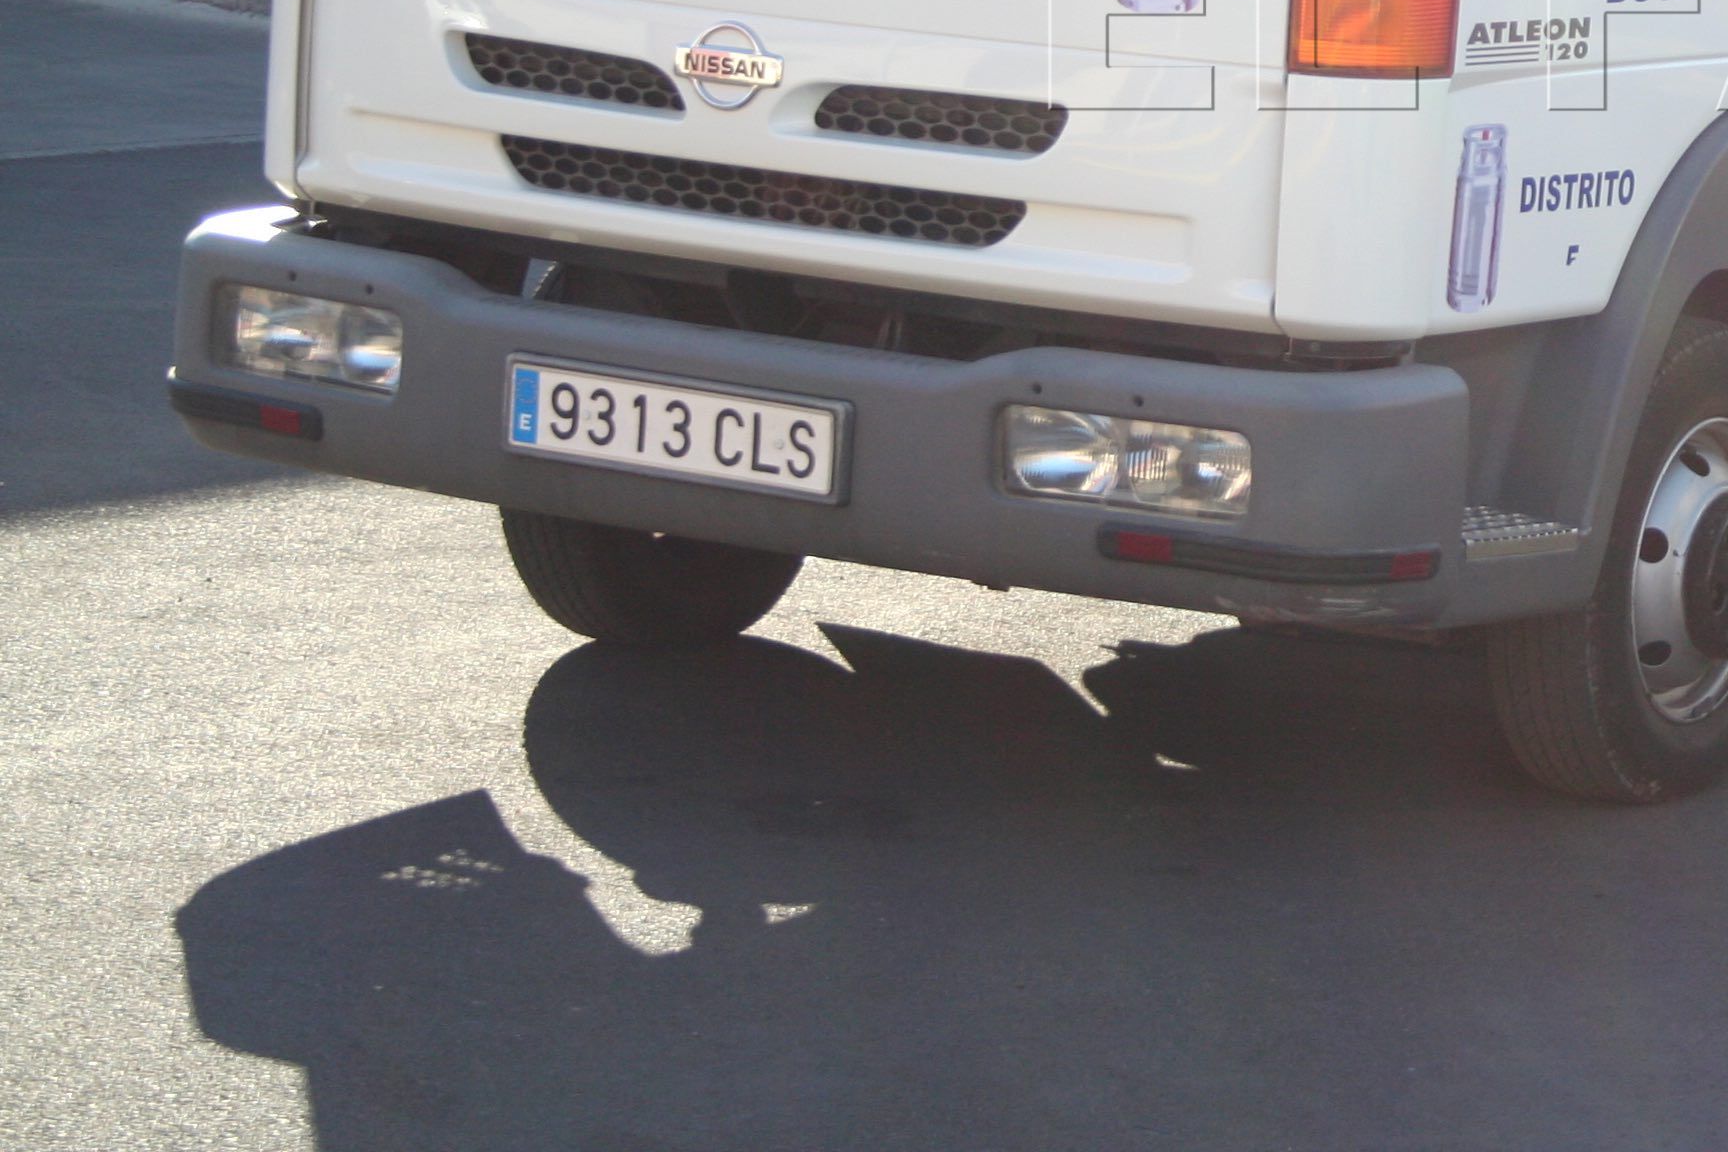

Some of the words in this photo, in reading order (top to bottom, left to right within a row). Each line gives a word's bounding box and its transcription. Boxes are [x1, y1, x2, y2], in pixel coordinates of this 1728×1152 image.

[1467, 16, 1591, 45] ATLEON
[1546, 41, 1588, 61] 120
[683, 52, 767, 79] NISSAN
[1519, 169, 1636, 213] DISTRITO
[518, 412, 532, 431] E
[550, 381, 692, 459] 9313
[714, 407, 816, 478] CLS
